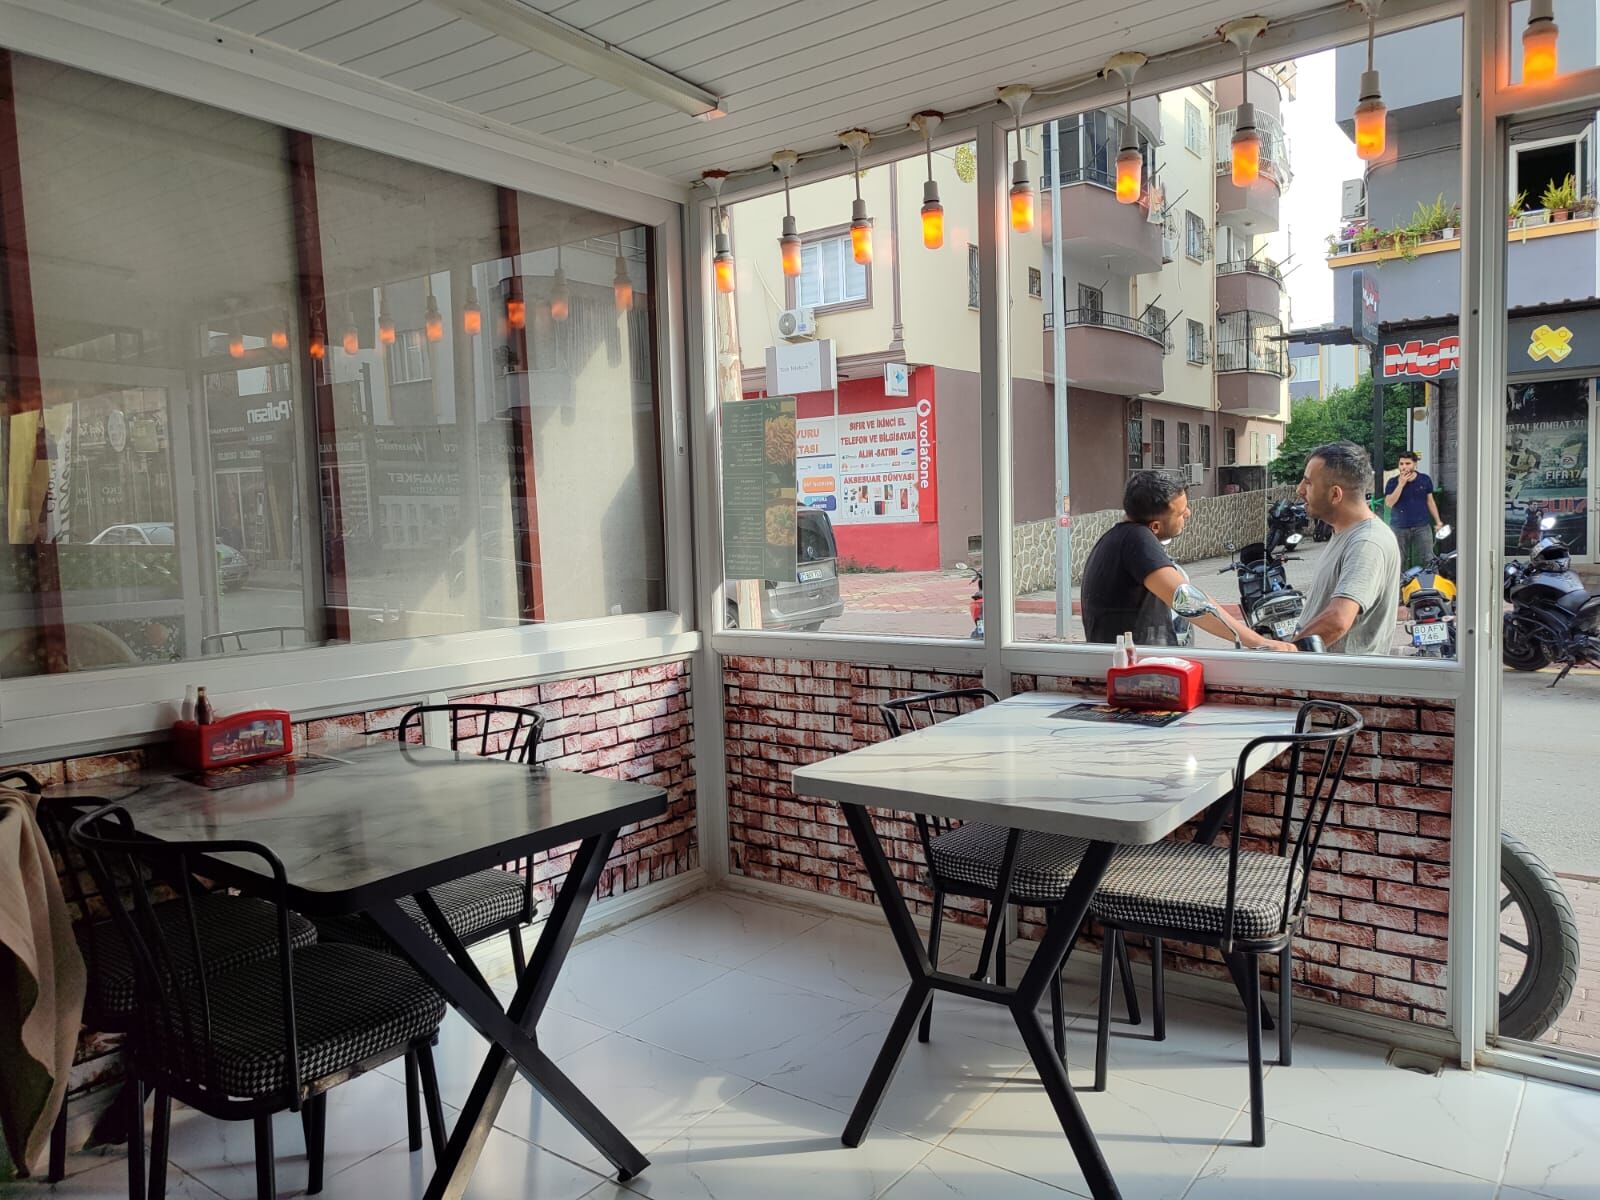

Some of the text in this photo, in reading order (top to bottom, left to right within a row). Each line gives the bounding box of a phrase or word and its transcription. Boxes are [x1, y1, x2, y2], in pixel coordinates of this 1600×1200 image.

[849, 416, 906, 431] SIFIR VE İKİNCİ EL
[840, 430, 917, 446] TELEFON VE BİLGİSAYAR
[858, 449, 874, 458] ALIM
[919, 420, 931, 489] vodafone
[843, 472, 915, 484] AKSESUAR DÜNYASI
[1546, 469, 1580, 480] FIFA 17
